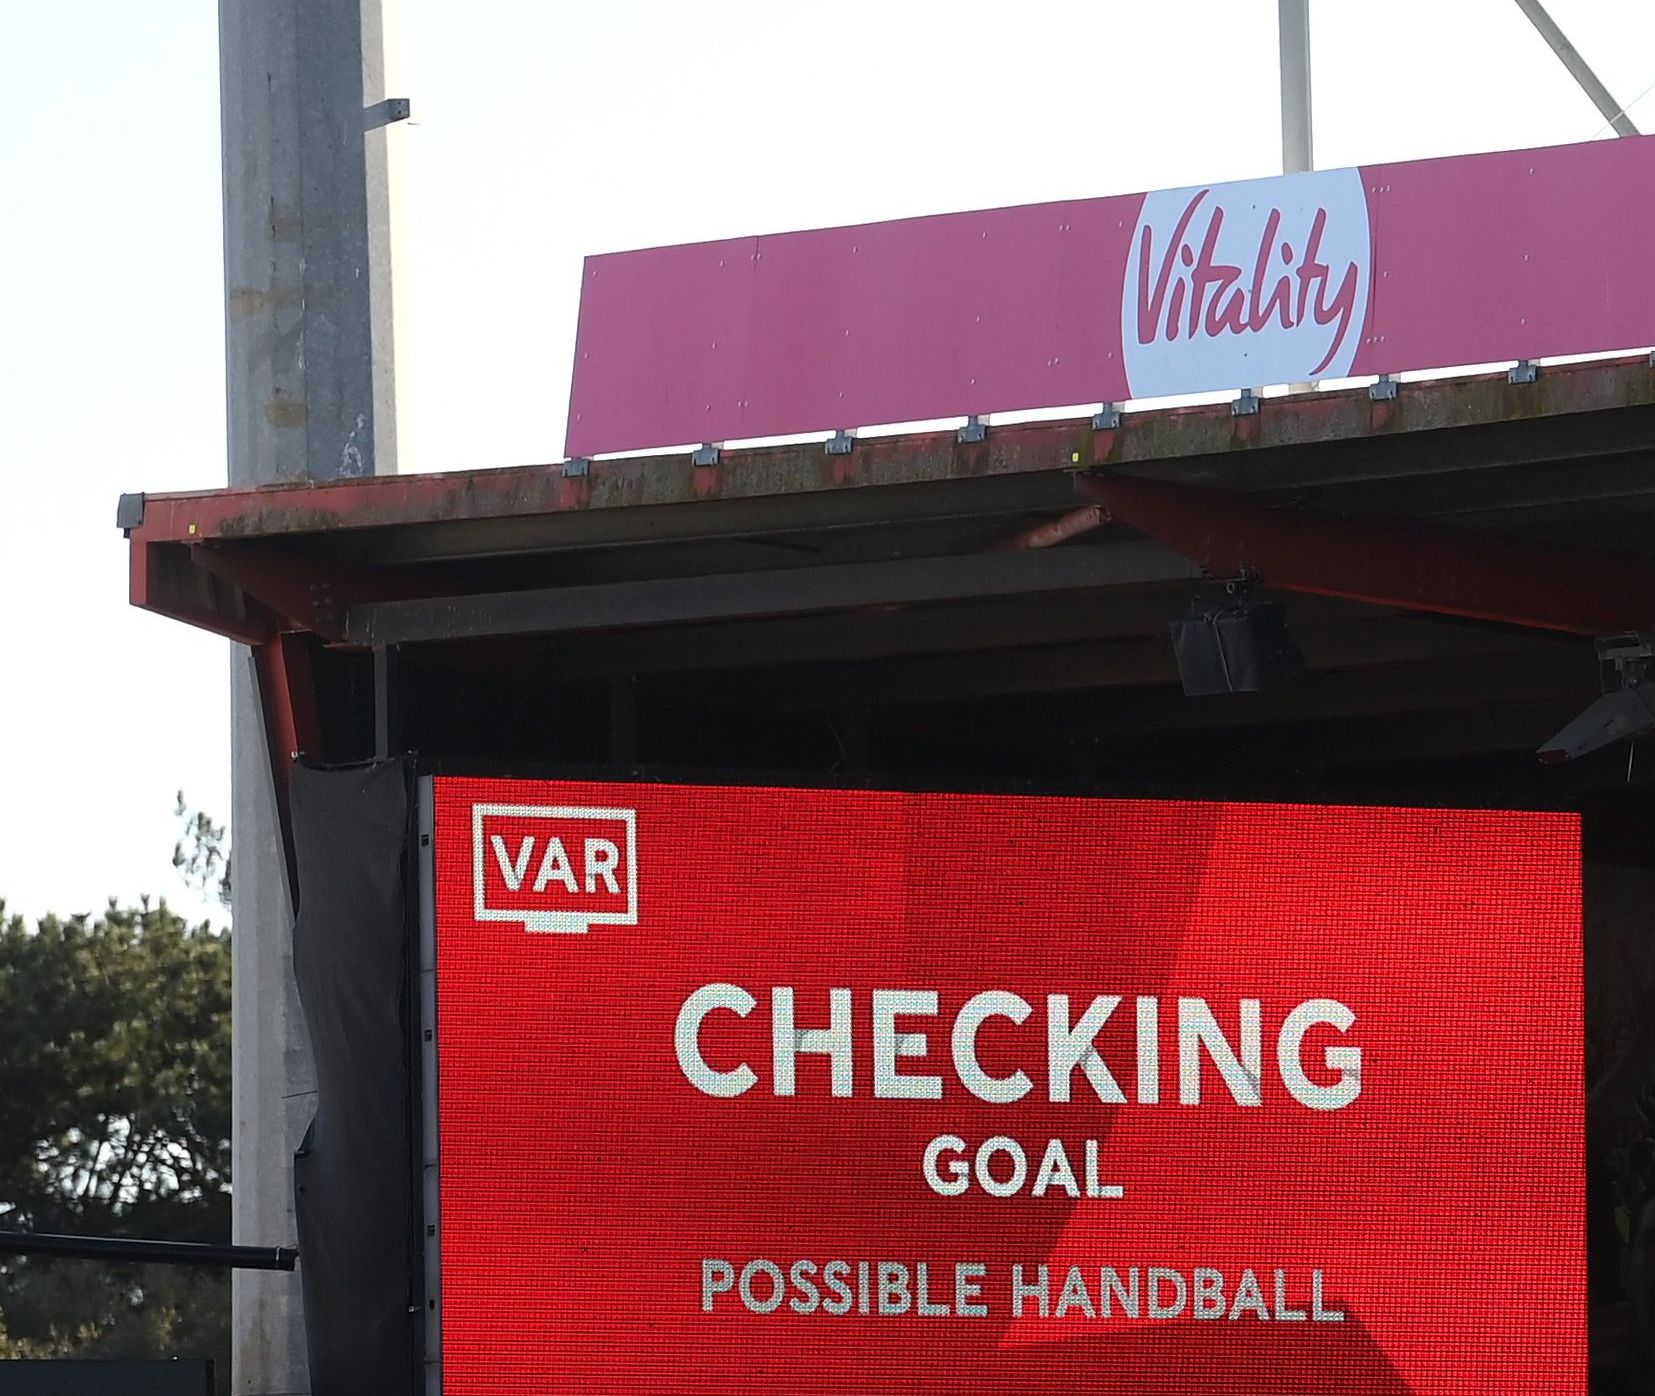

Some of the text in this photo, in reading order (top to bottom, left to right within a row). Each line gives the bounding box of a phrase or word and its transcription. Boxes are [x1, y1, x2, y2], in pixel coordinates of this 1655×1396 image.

[1137, 189, 1356, 376] Vitality
[491, 836, 621, 895] VAR
[673, 982, 1363, 1110] CHECKING
[923, 1136, 1124, 1199] GOAL
[701, 1258, 1345, 1322] POSSIBLE HANDBALL
